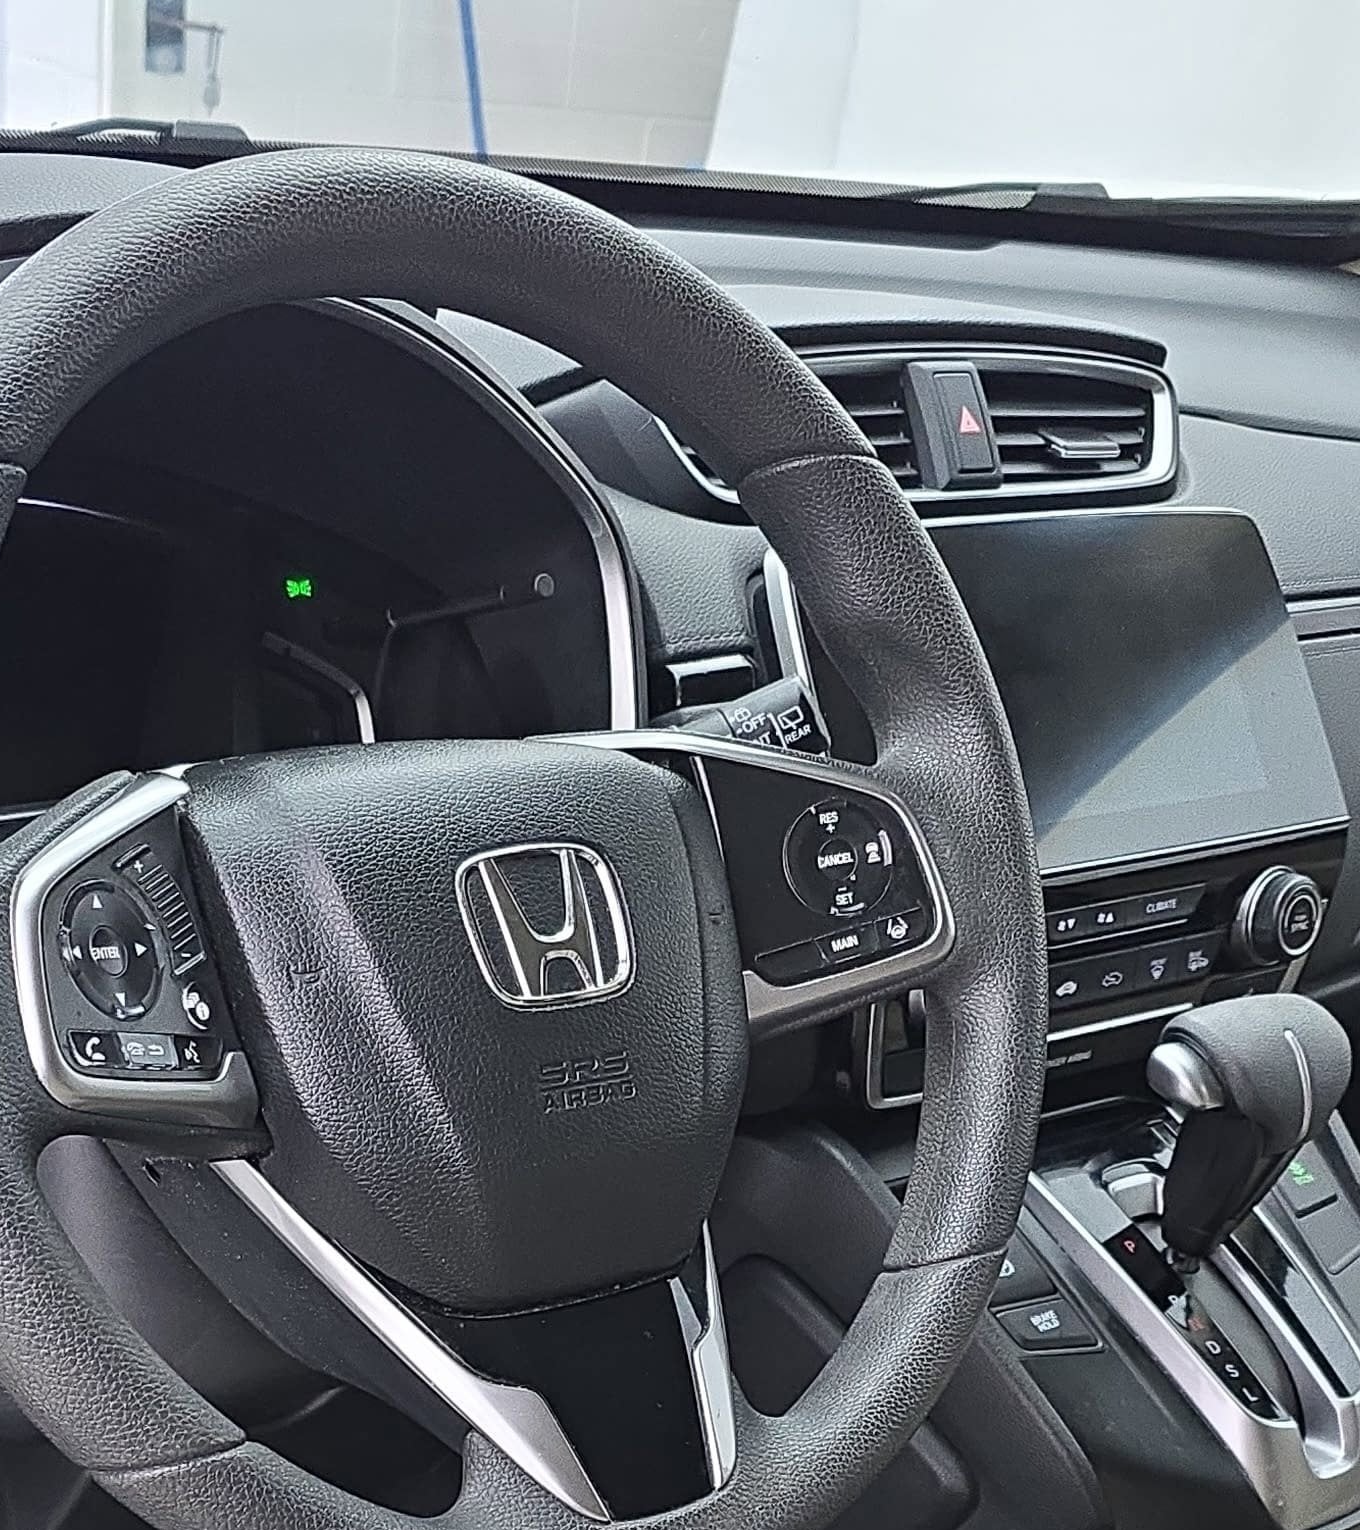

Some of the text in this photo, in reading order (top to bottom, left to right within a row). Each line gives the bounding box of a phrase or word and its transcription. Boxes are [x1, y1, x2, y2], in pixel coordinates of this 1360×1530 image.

[742, 713, 767, 733] OFF
[785, 724, 812, 745] REAR
[819, 811, 839, 825] RES
[817, 852, 854, 869] CANCEL
[835, 892, 854, 906] SET
[831, 935, 859, 953] MAIN
[90, 946, 121, 960] ENTER
[539, 1051, 630, 1089] SRS
[1123, 1240, 1137, 1254] P
[1205, 1340, 1223, 1355] D
[1225, 1364, 1240, 1378] S
[1242, 1387, 1259, 1402] L
